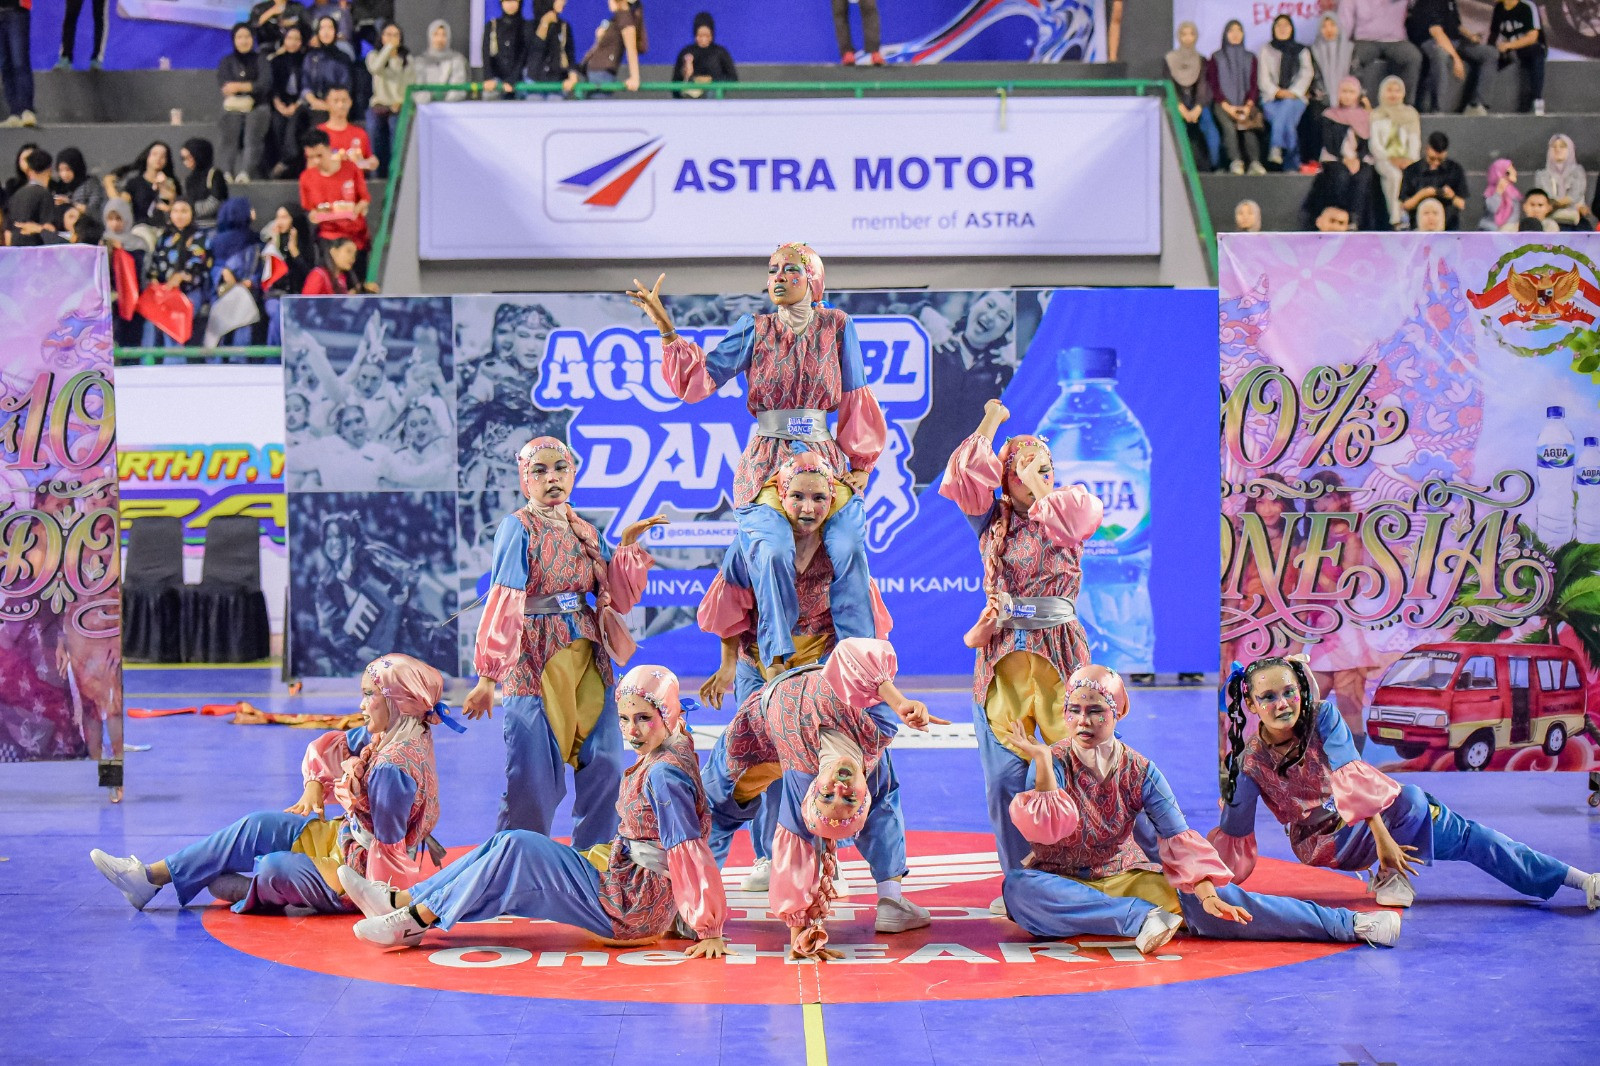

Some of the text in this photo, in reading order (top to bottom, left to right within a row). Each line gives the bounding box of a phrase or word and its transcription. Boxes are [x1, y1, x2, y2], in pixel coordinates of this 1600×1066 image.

[674, 156, 1034, 192] ASTRA MOTOR
[852, 211, 1036, 230] member of ASTRA
[542, 333, 917, 412] AQU BL
[117, 450, 205, 481] RTH
[1543, 448, 1569, 458] AQUA
[576, 422, 757, 537] DAN
[910, 577, 981, 593] KAMU
[427, 946, 691, 967] One
